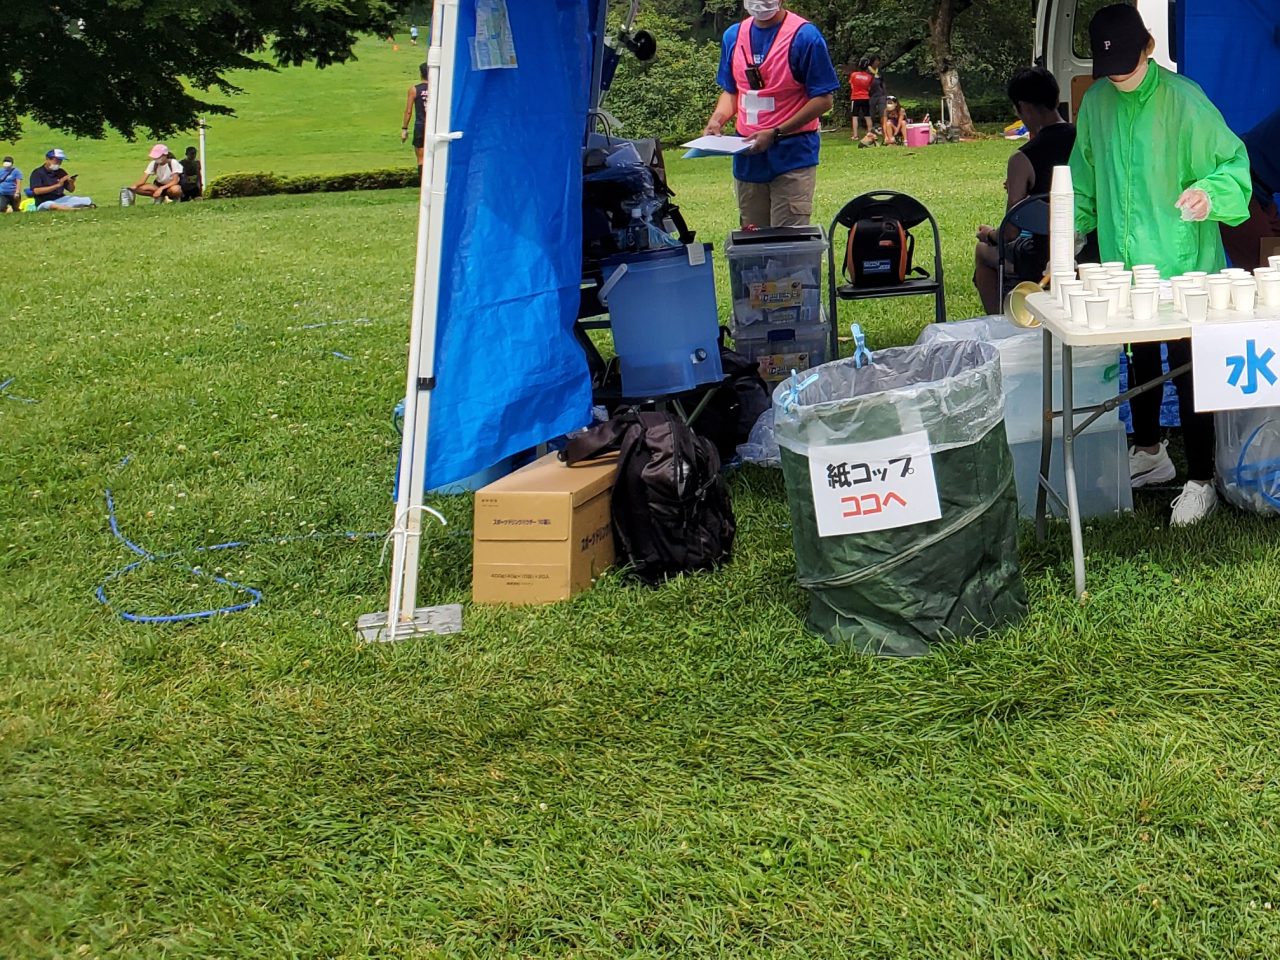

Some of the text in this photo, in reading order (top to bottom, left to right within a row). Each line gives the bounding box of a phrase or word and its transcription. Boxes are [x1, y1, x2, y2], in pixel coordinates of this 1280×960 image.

[1225, 339, 1279, 395] 水
[826, 454, 915, 489] 紙コップ
[840, 491, 908, 518] ココへ
